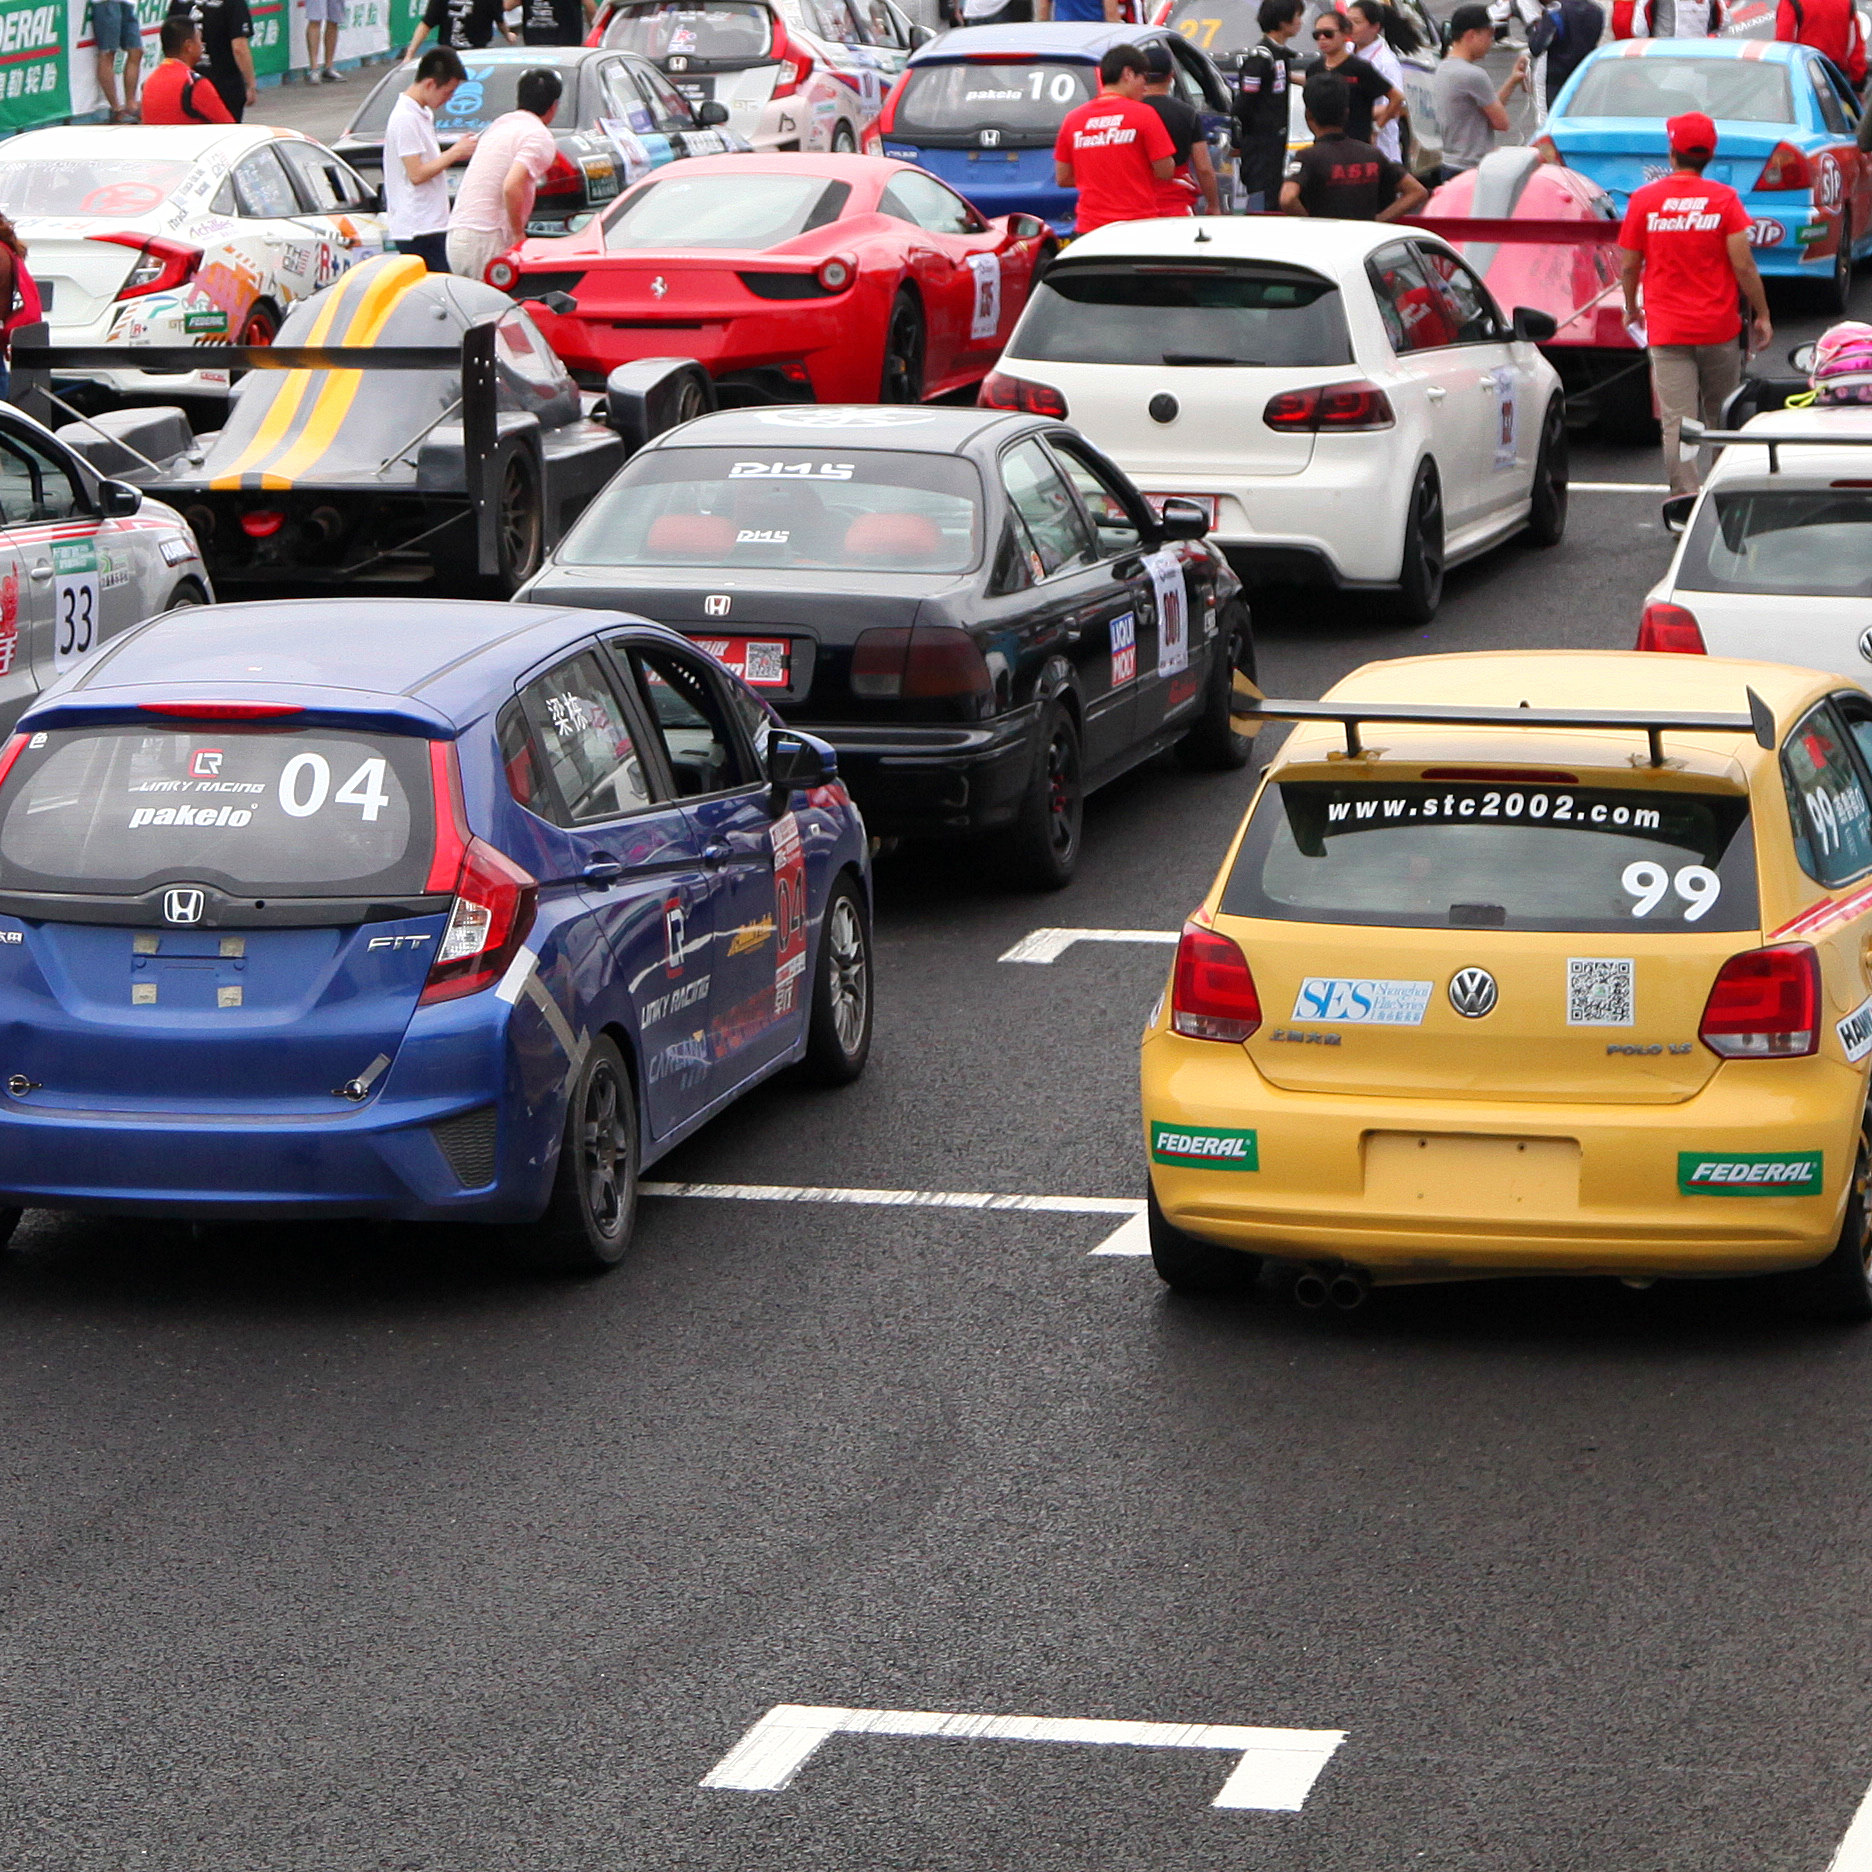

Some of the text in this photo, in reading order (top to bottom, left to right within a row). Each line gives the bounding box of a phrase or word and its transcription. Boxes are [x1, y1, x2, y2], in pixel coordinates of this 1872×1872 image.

[1179, 19, 1223, 48] 27
[965, 71, 1076, 104] pakelo 10
[1072, 127, 1137, 149] TrackFun
[1330, 162, 1380, 180] ASR
[1647, 211, 1722, 232] TrackFun
[1745, 219, 1781, 246] STP
[59, 584, 94, 656] 33
[194, 781, 266, 794] RACING
[278, 751, 390, 822] 04
[127, 804, 254, 829] pakelo
[1327, 789, 1663, 831] www.stc2002.com
[1619, 859, 1722, 924] 99
[367, 932, 431, 953] FIT
[1296, 980, 1378, 1020] SES
[1606, 1043, 1663, 1057] POLO
[1156, 1132, 1250, 1159] FEDERAL
[1691, 1160, 1815, 1186] FEDERAL
